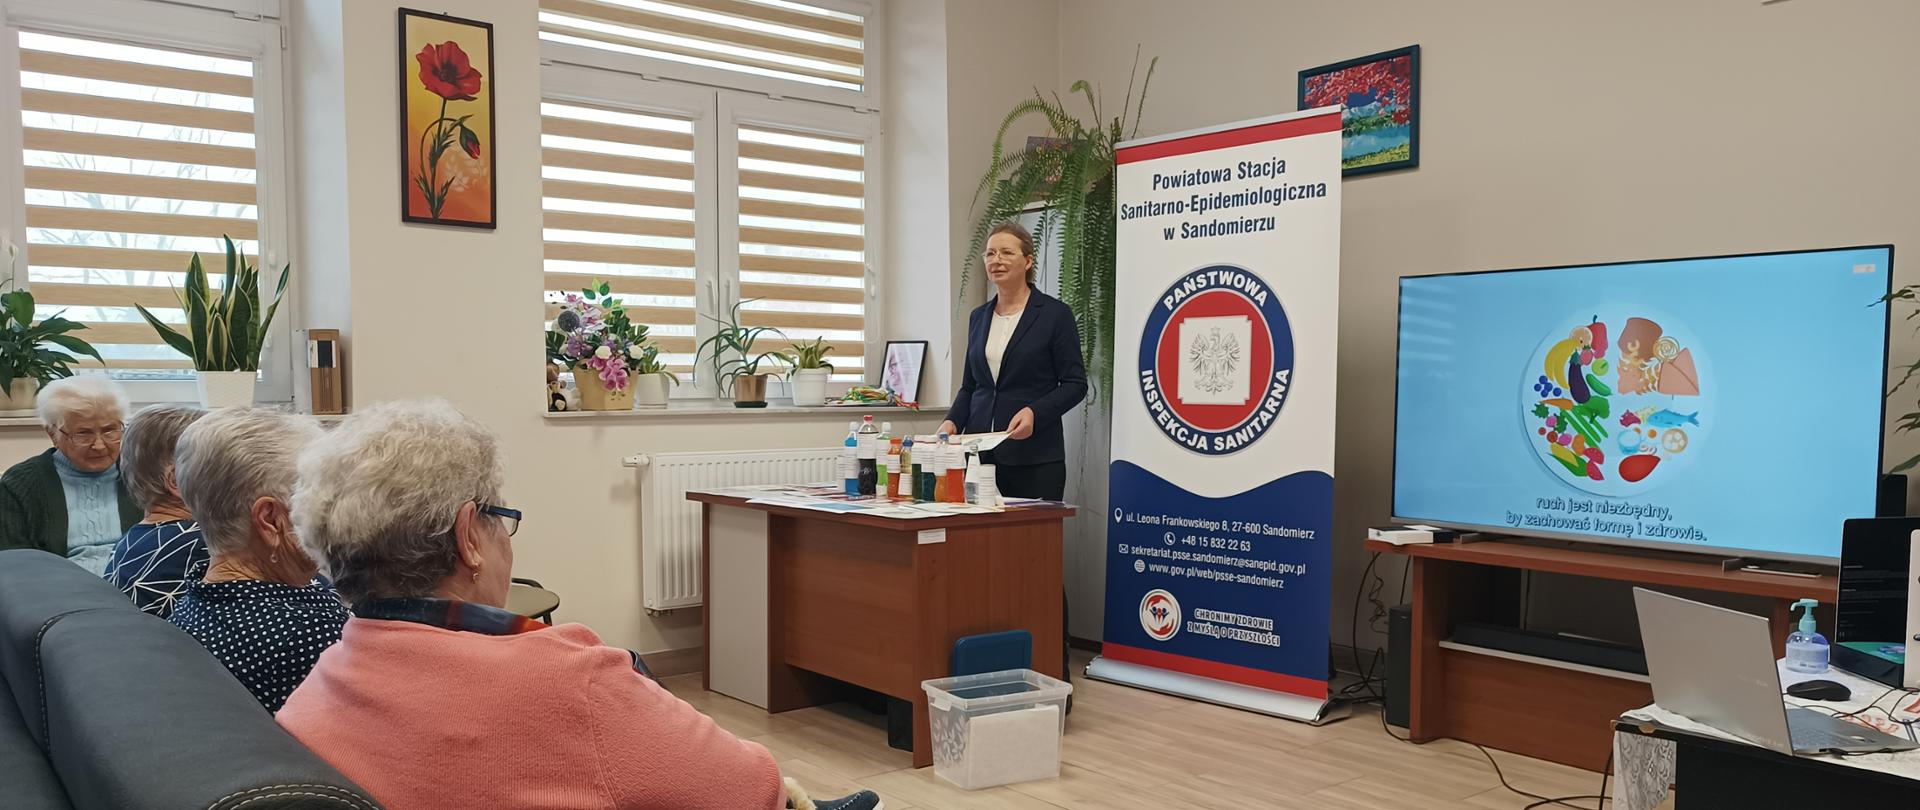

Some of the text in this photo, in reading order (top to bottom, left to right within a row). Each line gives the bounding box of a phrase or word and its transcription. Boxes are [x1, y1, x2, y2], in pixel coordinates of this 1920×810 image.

[1153, 157, 1286, 190] Powiatowa Stacja
[1121, 182, 1327, 220] Sanitarno-Epidemiologiczna
[1163, 216, 1275, 241] w Sandomierzu
[1163, 270, 1269, 311] PAŃSTWOWA
[1141, 369, 1290, 451] INSPEKCJA SANITARNA
[1536, 497, 1565, 510] ruch
[1567, 498, 1593, 513] jest
[1126, 512, 1315, 539] ul. Leona Frankowskiego 8, 27-600 Sandomierz
[1506, 510, 1522, 527] by
[1524, 513, 1590, 530] zachować
[1593, 518, 1633, 537] formę
[1645, 524, 1707, 541] zdrowie.
[1181, 535, 1251, 552] +48 15 832 22 63
[1131, 545, 1306, 575] sekretariat.psse.sandomierz@sanepid.gov.pl
[1149, 564, 1284, 588] www.gov.pl/web/psse-sandomierz
[1195, 608, 1273, 631] CHRONIMY ZDROWIE
